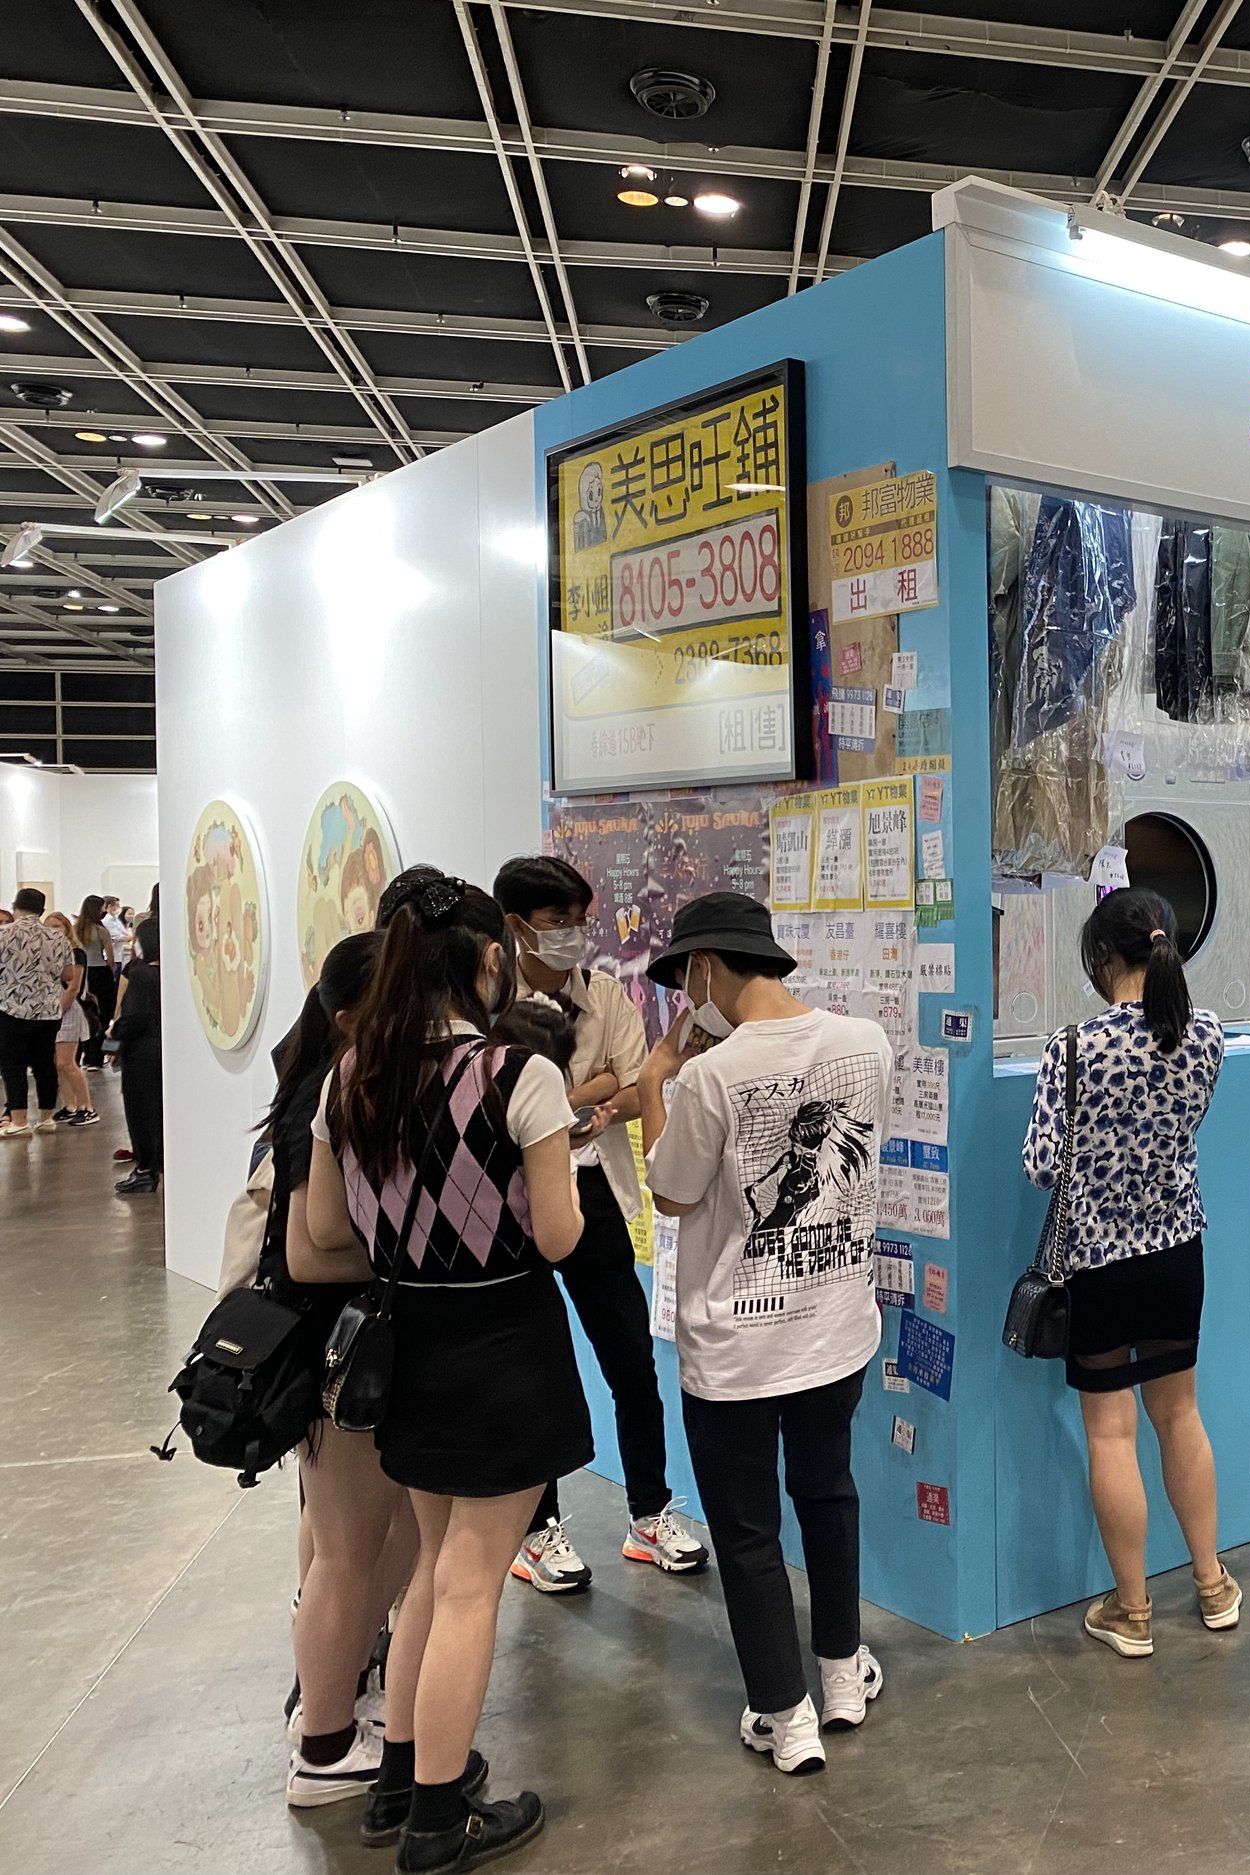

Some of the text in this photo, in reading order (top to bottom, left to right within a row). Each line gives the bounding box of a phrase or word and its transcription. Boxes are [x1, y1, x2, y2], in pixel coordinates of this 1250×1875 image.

[861, 473, 934, 521] 邦富物業
[843, 528, 934, 574] 2094 1888
[619, 524, 780, 627] 8105-3808
[850, 568, 918, 614] 出租
[606, 867, 639, 879] Happy Hours
[723, 864, 763, 878] Happy Hours
[624, 881, 633, 892] pm
[744, 880, 755, 890] pm
[912, 1056, 945, 1077] 美華樓
[738, 1077, 805, 1109] アスカ
[777, 1252, 804, 1281] THE
[808, 1243, 847, 1275] DEATH
[850, 1238, 864, 1266] OF
[881, 1241, 898, 1254] 9973
